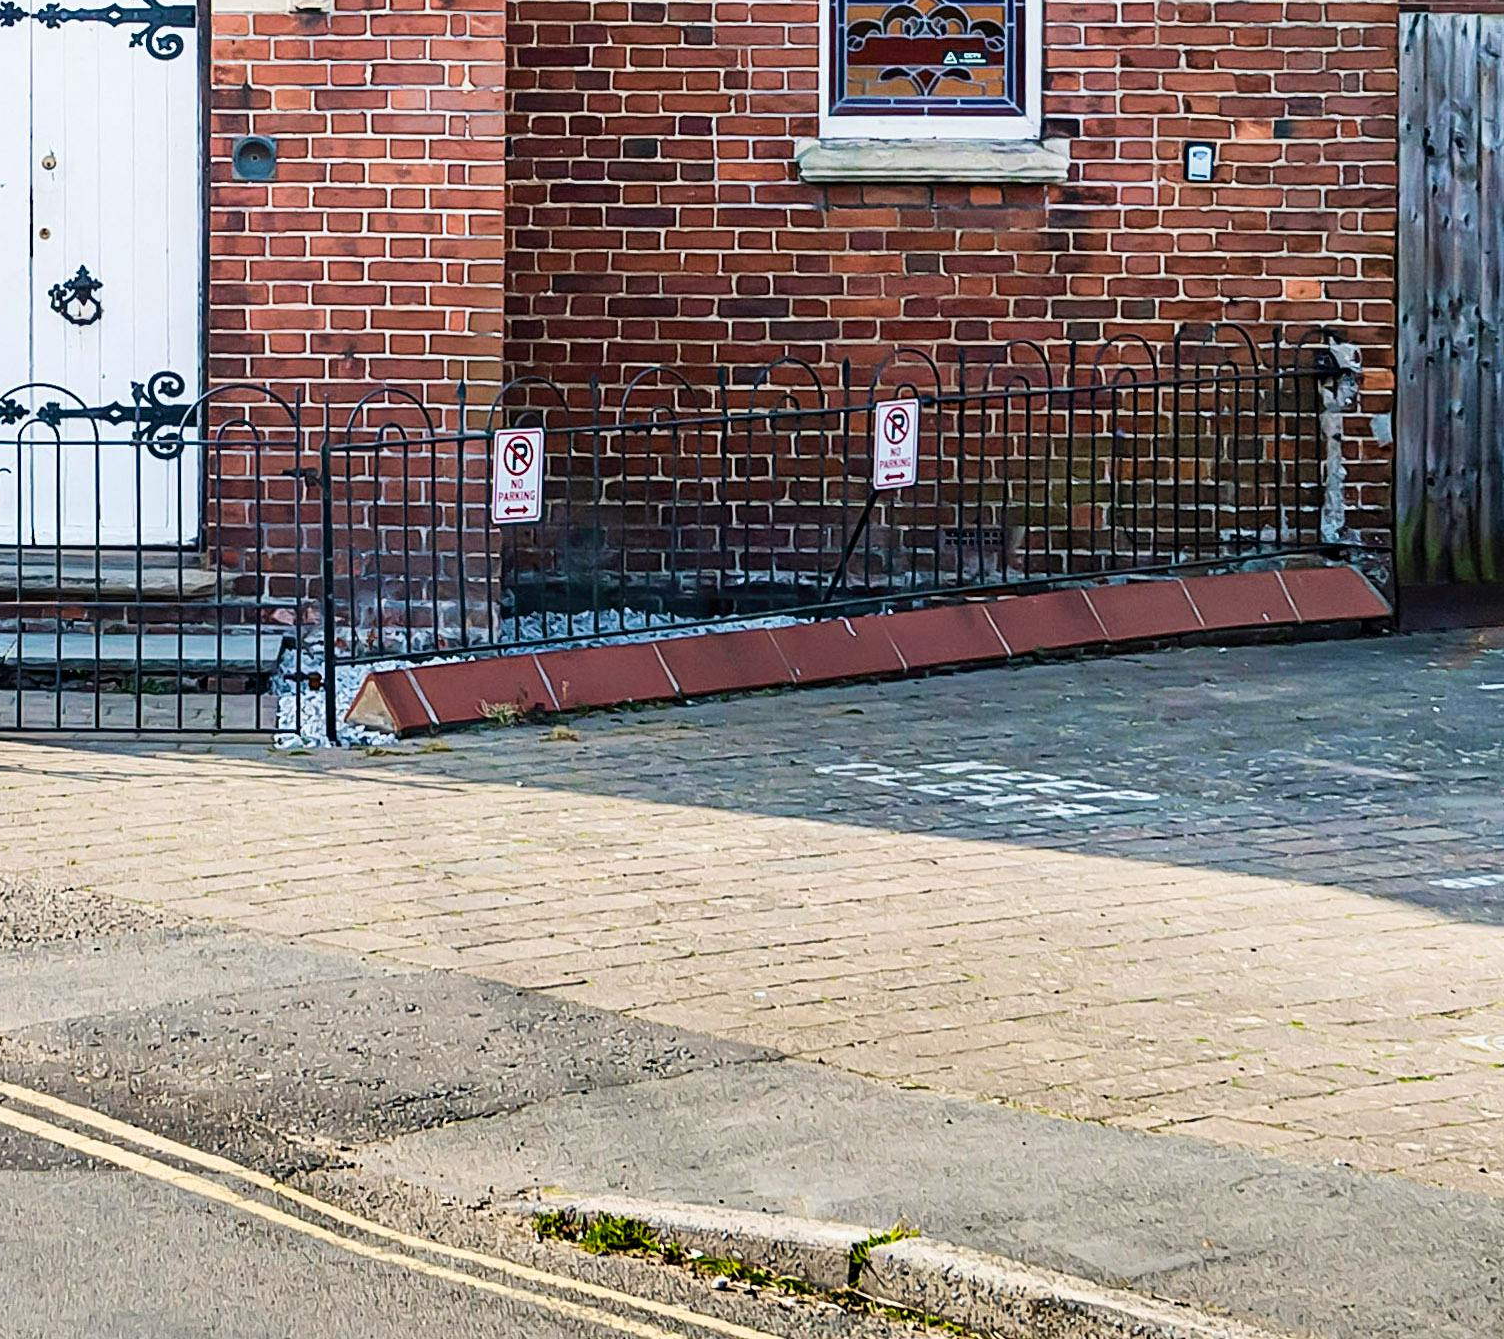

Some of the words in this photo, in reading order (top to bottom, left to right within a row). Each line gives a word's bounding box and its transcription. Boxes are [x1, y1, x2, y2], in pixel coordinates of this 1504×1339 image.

[890, 448, 902, 457] NO
[879, 457, 912, 469] PARKING
[510, 478, 524, 489] NO
[498, 490, 536, 503] PARKING
[916, 760, 1161, 802] KEEP
